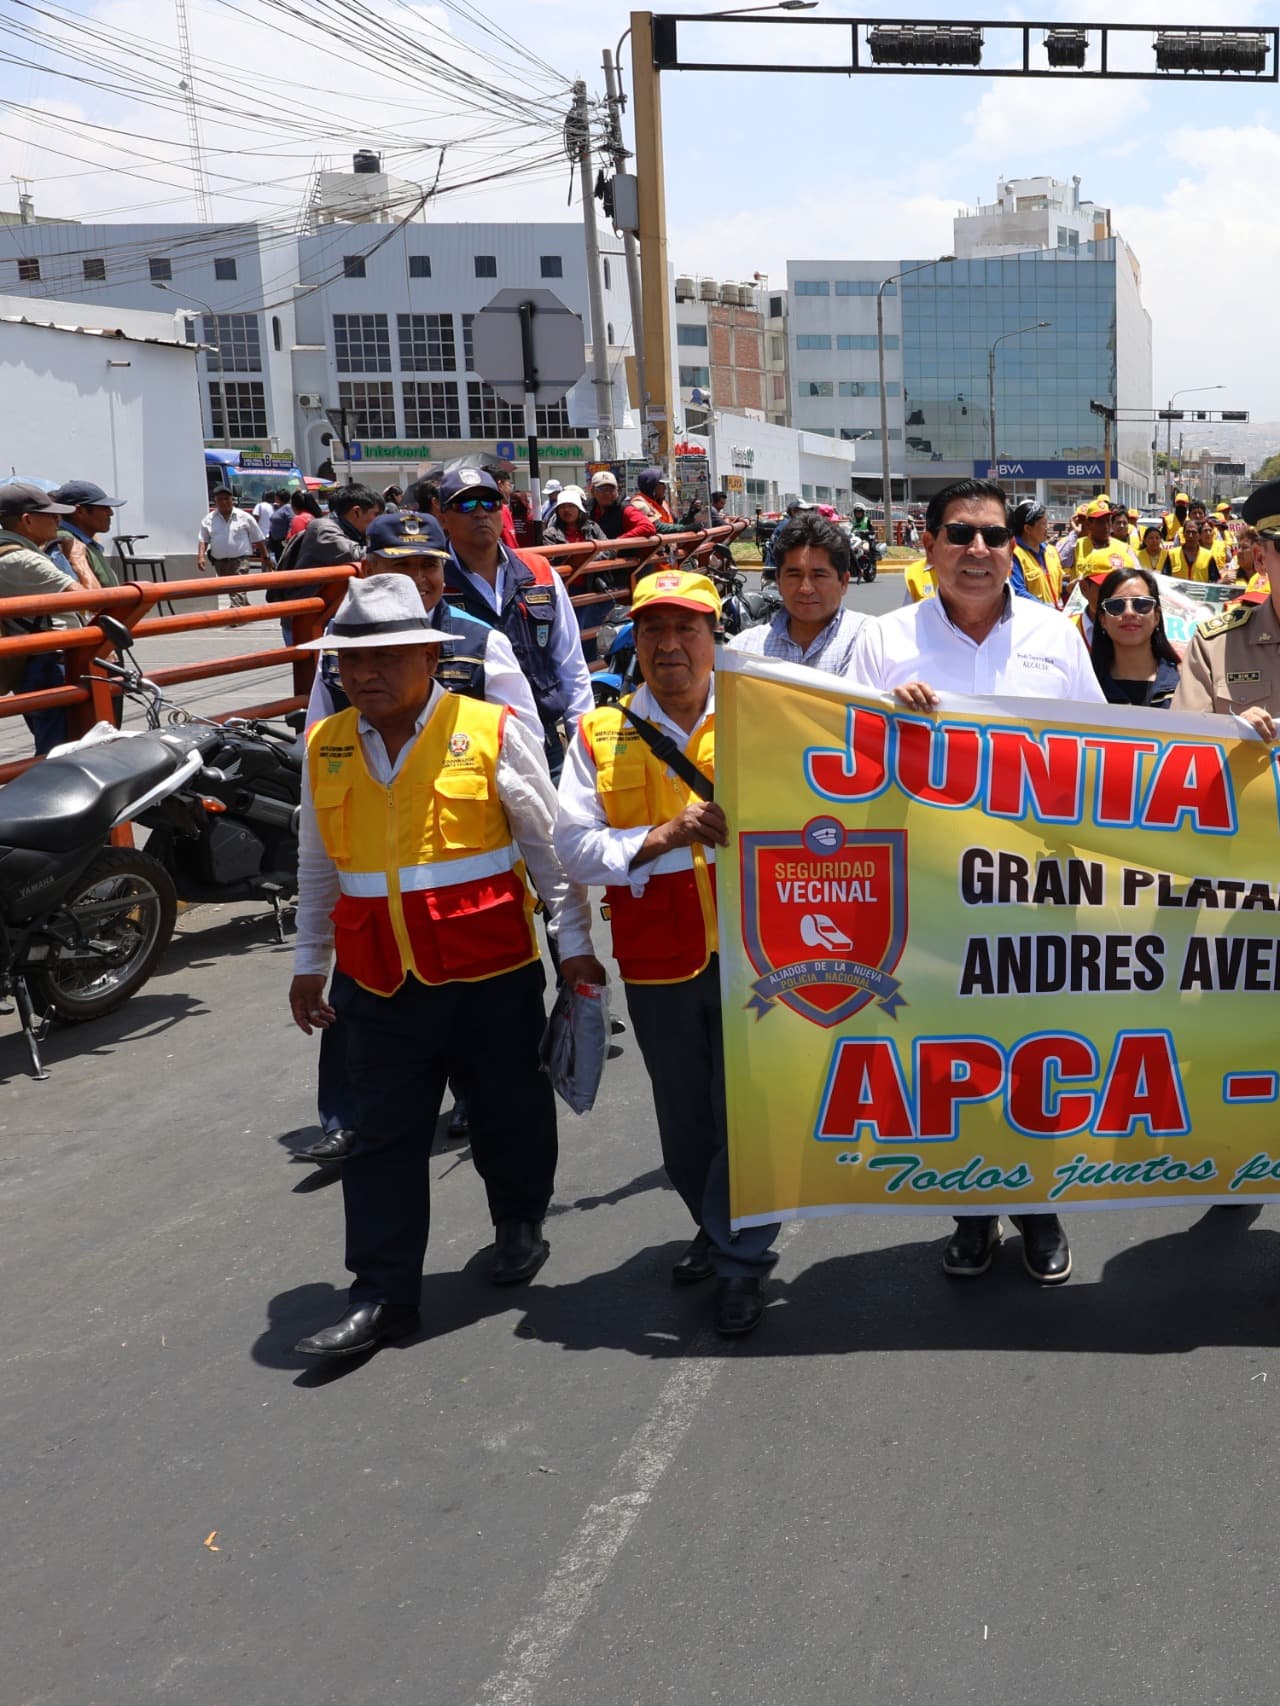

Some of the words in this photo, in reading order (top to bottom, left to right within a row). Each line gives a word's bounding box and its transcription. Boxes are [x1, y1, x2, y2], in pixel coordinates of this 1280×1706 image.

[364, 445, 430, 458] Interbank
[517, 445, 583, 458] Inerbank
[1067, 464, 1101, 475] BBVA
[805, 706, 1237, 835] JUNTA
[774, 861, 876, 879] SEGURIDAD
[961, 847, 1104, 906] GRAN
[18, 874, 56, 898] YAMAHA
[776, 880, 878, 904] VECINAL
[769, 963, 807, 985] ALIADOS
[815, 961, 827, 972] DE
[834, 961, 846, 972] LA
[853, 964, 883, 983] NUEVA
[959, 934, 1166, 996] ANDRES
[781, 972, 817, 990] POLICIA
[824, 972, 870, 989] NACIONAL
[814, 1029, 1191, 1143] APCA
[1049, 1154, 1217, 1200] juntos
